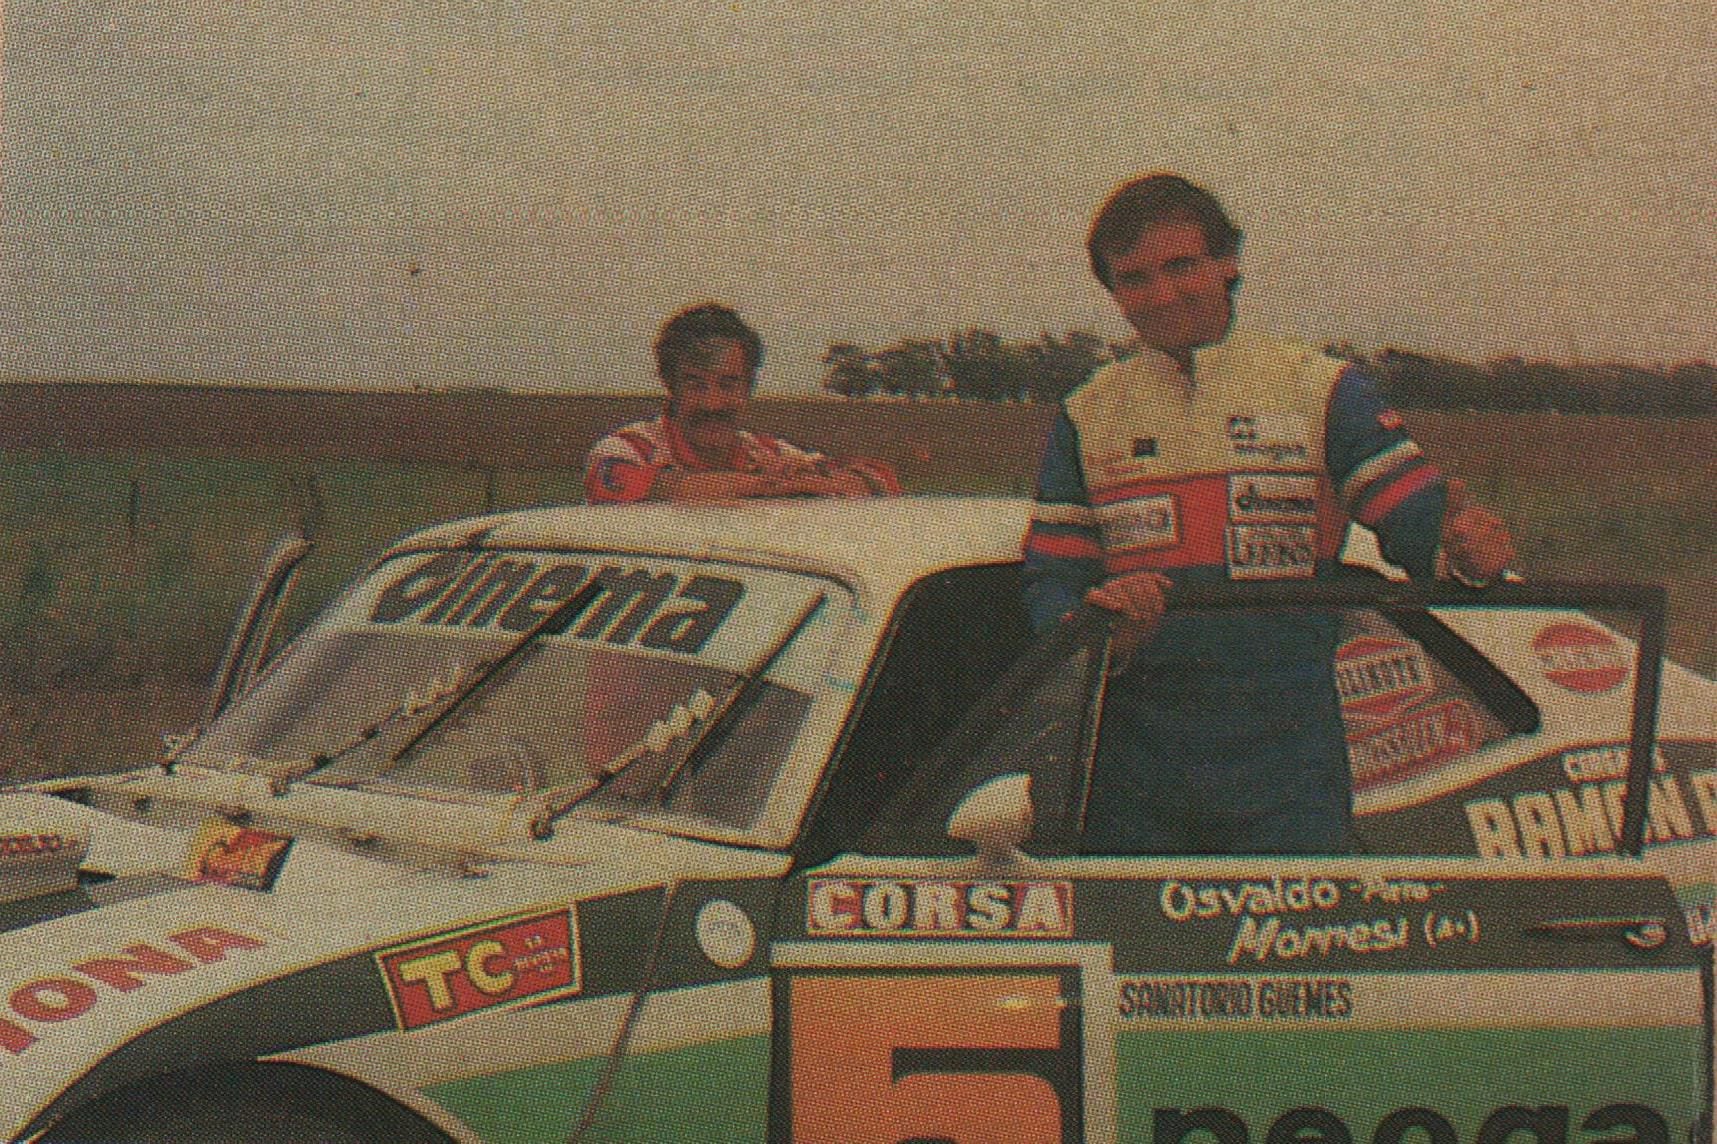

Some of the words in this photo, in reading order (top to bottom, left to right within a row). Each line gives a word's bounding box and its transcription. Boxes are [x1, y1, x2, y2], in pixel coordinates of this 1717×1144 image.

[812, 882, 1065, 931] CORSA
[1160, 874, 1342, 922] Osvaldo
[398, 940, 515, 1012] TC
[1257, 979, 1353, 1018] GUEMES
